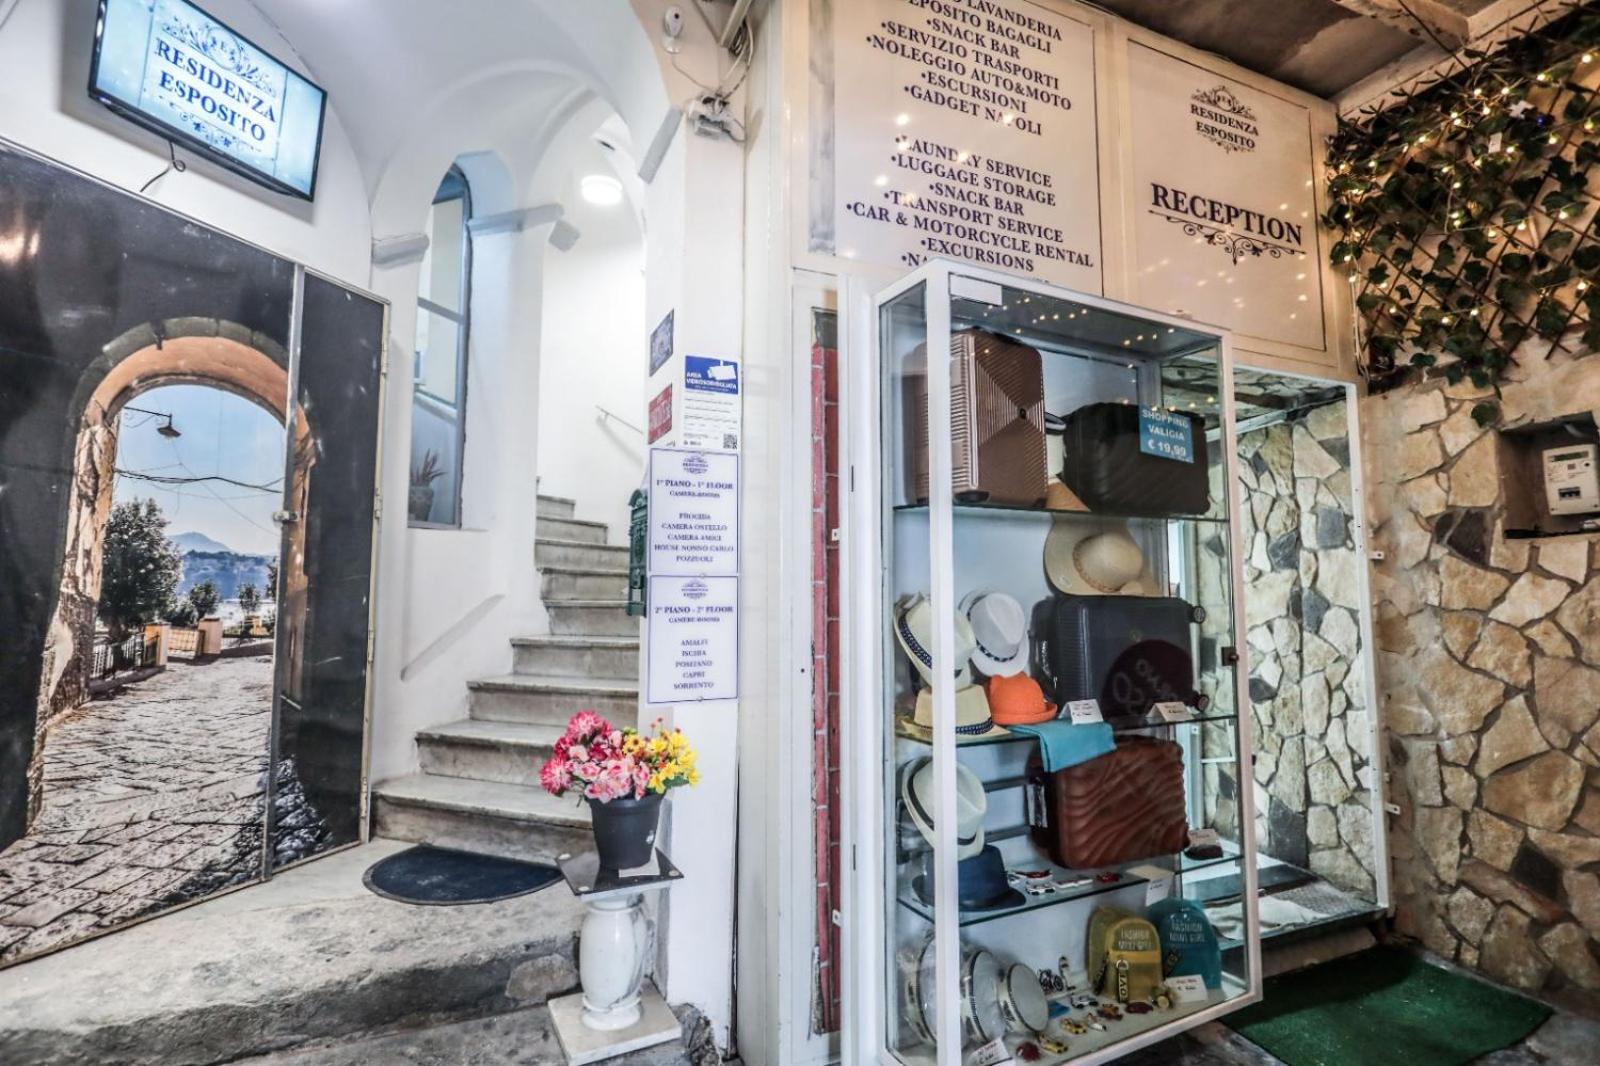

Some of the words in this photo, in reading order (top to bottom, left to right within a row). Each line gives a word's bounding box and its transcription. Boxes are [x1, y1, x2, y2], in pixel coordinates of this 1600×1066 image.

[967, 0, 1062, 41] LAVANDERIA
[986, 19, 1052, 54] BAGAGLI
[991, 38, 1020, 60] BAR
[154, 38, 276, 123] RESIDENZA
[971, 49, 1059, 90] TRASPORTI
[970, 65, 1072, 110] AUTO&MOTO
[158, 70, 266, 142] ESPOSITO
[984, 106, 1042, 136] NAOLI
[1190, 103, 1259, 136] RESIDENZA
[1196, 120, 1255, 149] ESPOSITO
[986, 158, 1052, 188] SERVICE
[983, 176, 1056, 207] STORAGE
[994, 197, 1024, 216] BAR
[999, 216, 1064, 243] SERVICE
[1151, 182, 1302, 246] RECEPTION
[896, 212, 908, 226] &
[914, 215, 1031, 253] MOTORCYCLE
[1034, 246, 1094, 268] RENTAL
[1147, 424, 1185, 440] VALIGIA
[665, 479, 691, 487] PIANO
